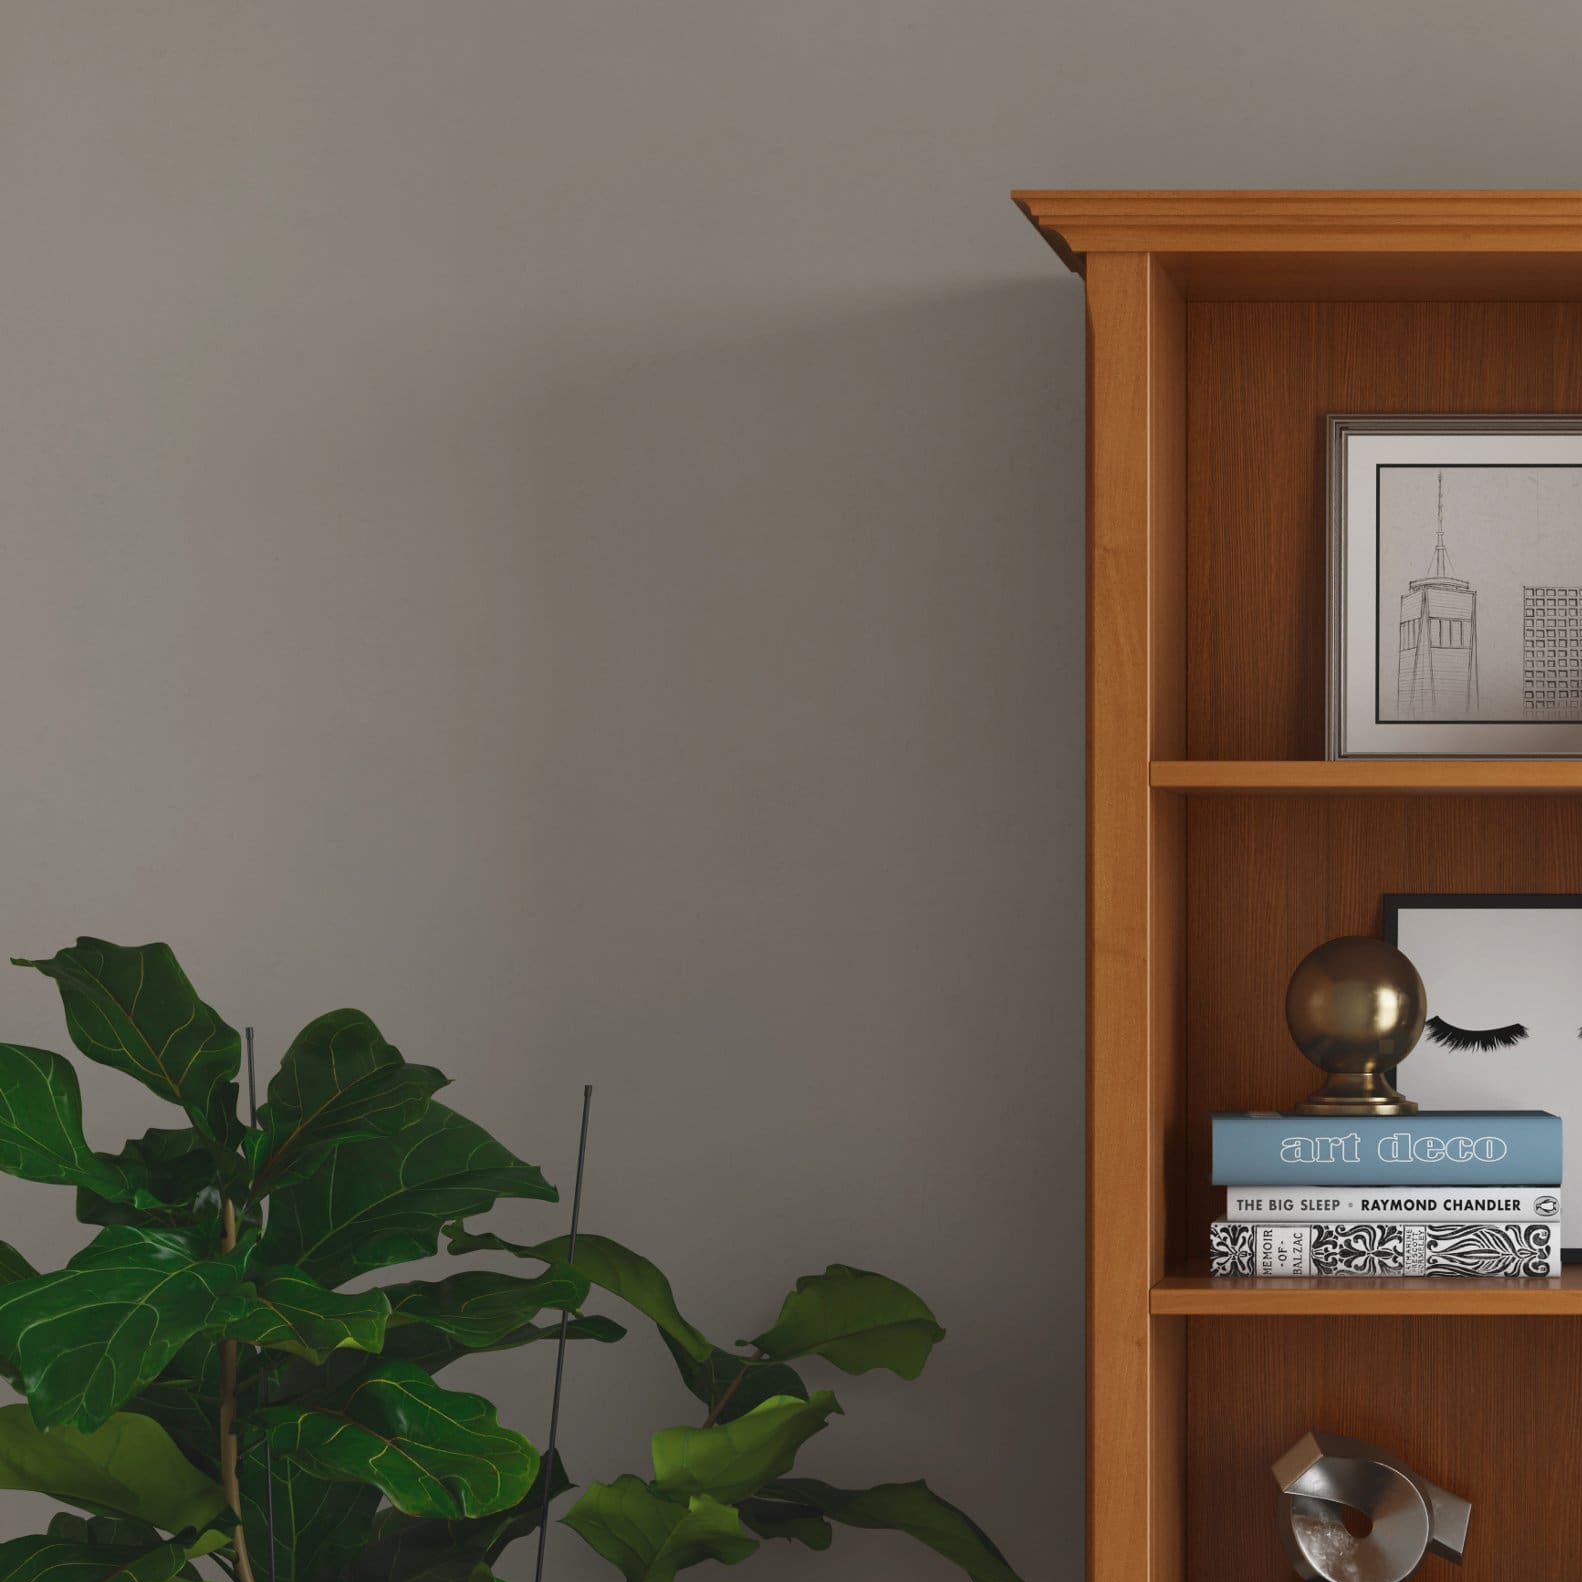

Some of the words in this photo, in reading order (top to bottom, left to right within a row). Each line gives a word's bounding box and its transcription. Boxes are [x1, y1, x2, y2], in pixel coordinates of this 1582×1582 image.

[1280, 1132, 1362, 1163] art
[1377, 1132, 1508, 1163] deco
[1236, 1199, 1263, 1211] THE
[1268, 1198, 1294, 1212] BIG
[1300, 1199, 1341, 1212] SLEEP
[1361, 1198, 1438, 1212] RAYMOND
[1443, 1198, 1521, 1212] CHANDLER
[1263, 1229, 1273, 1276] MEMOIR
[1292, 1232, 1304, 1276] BALZAC
